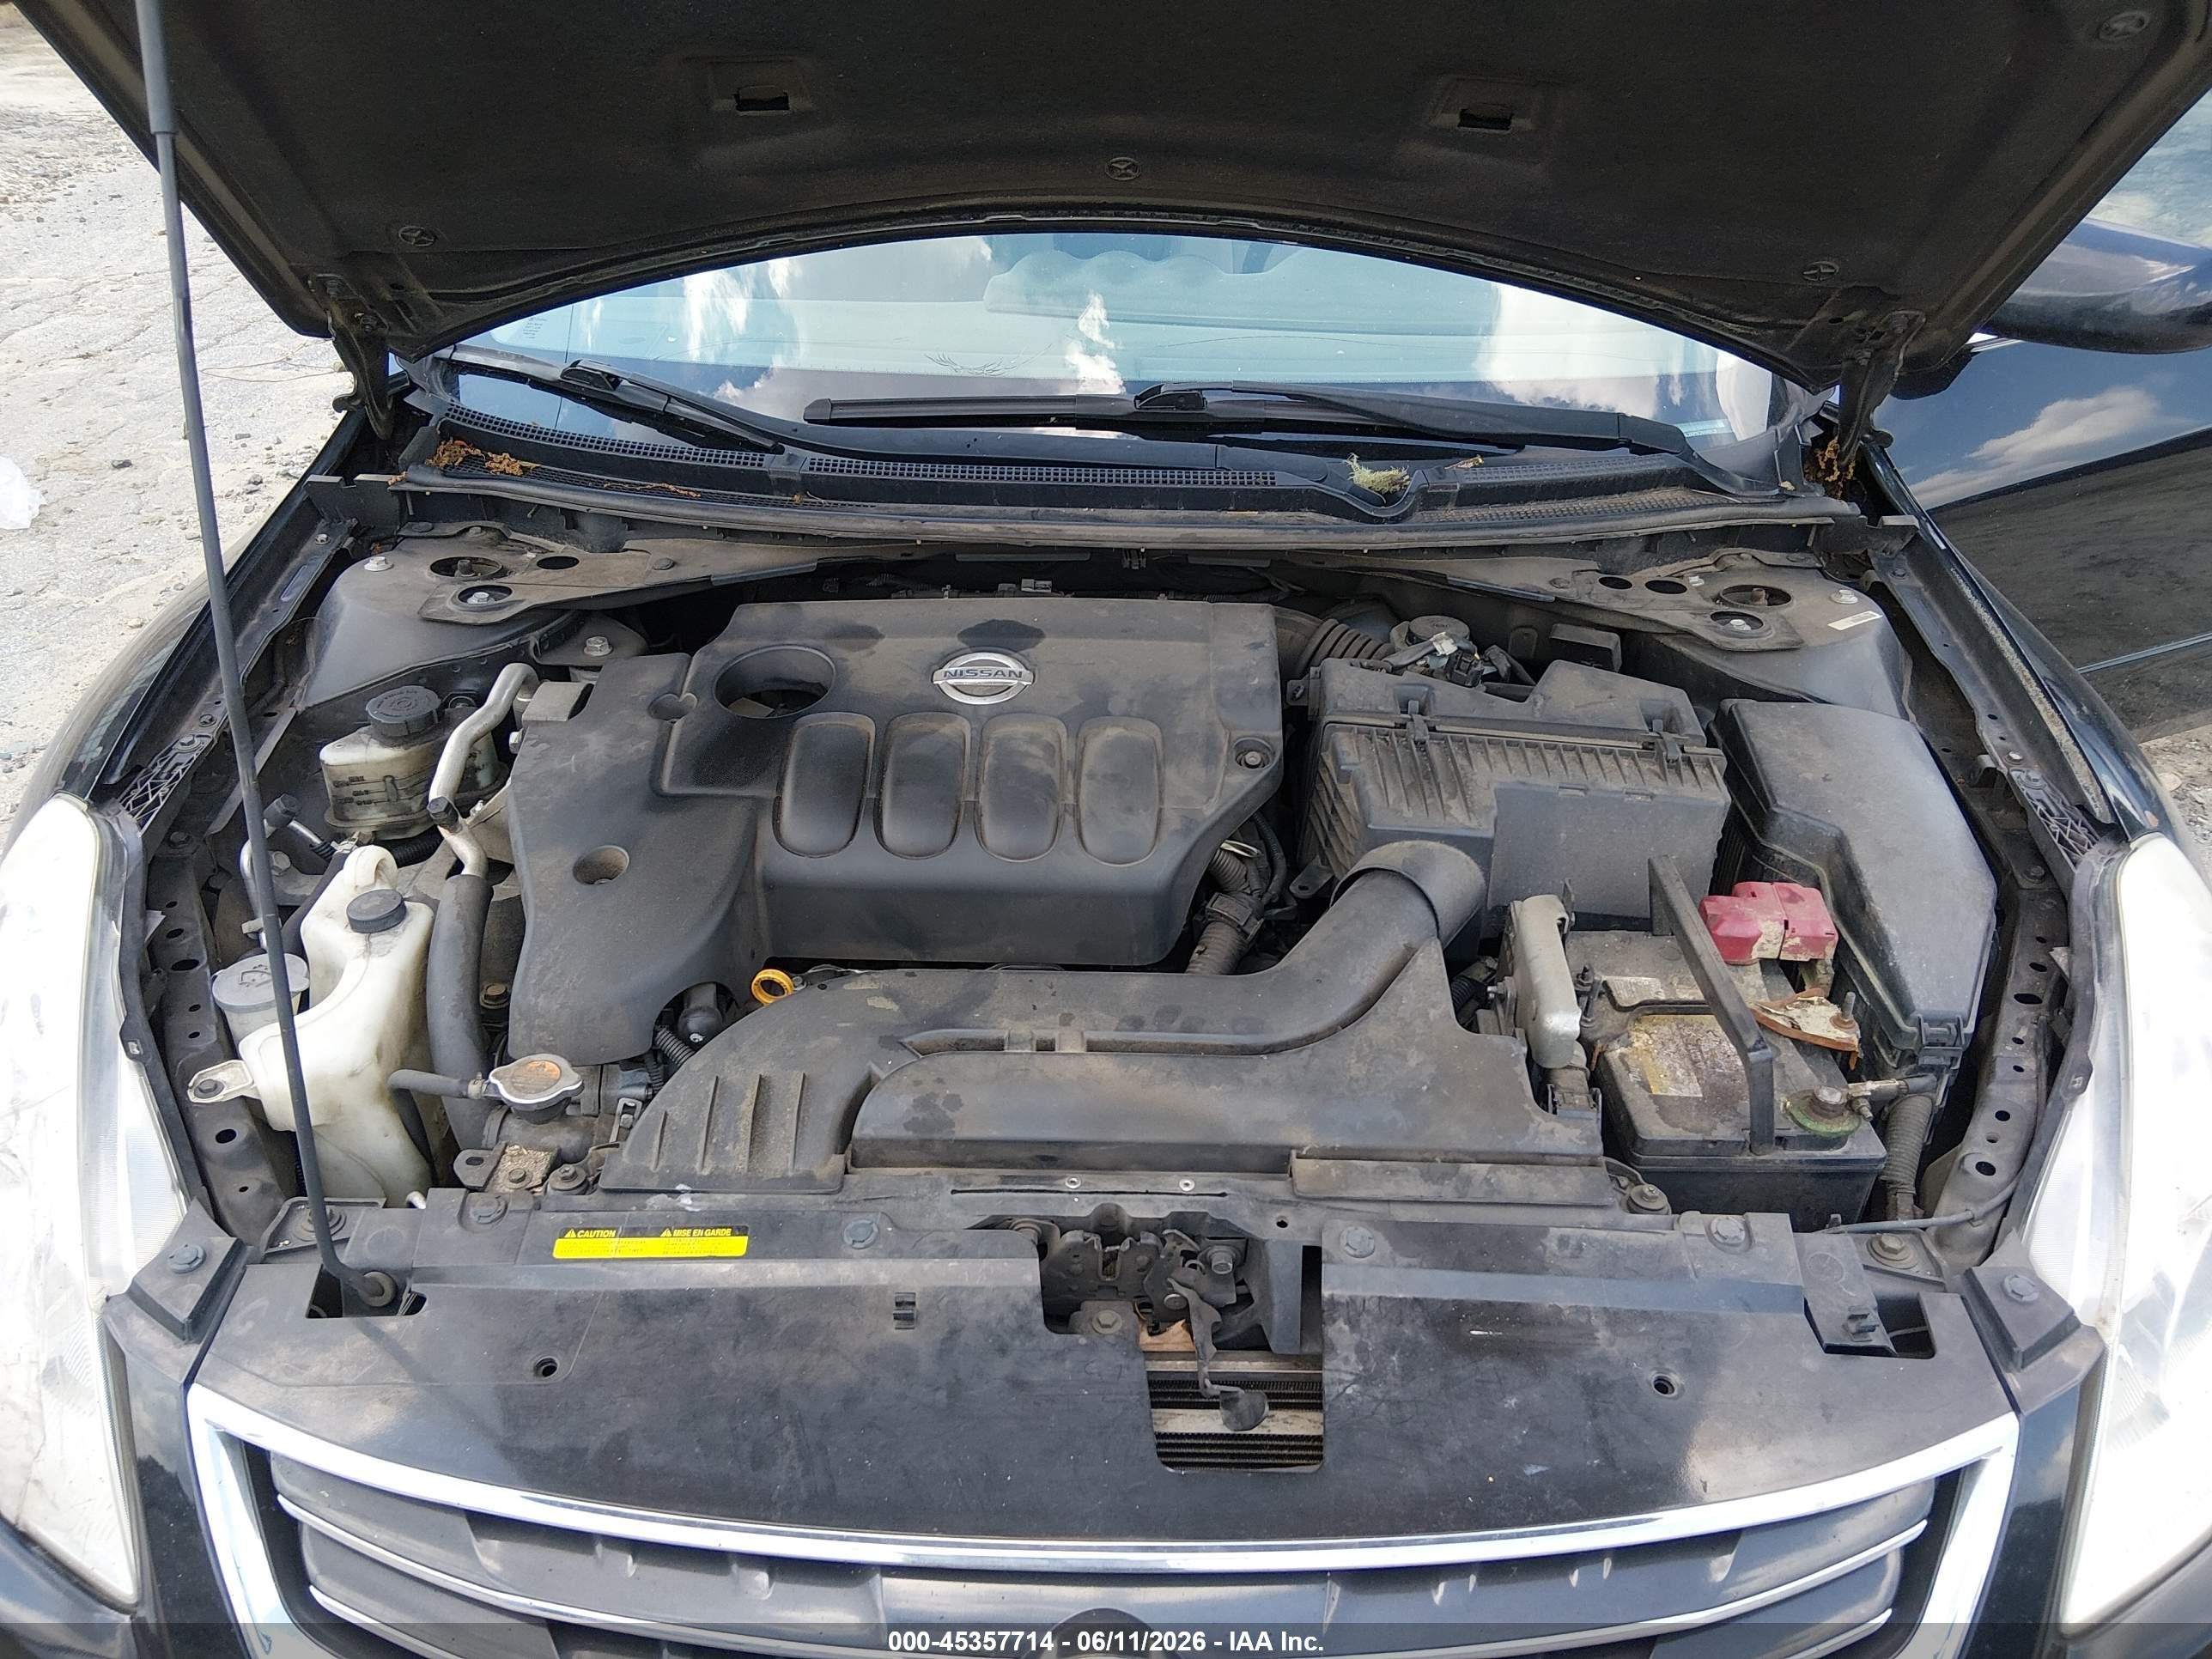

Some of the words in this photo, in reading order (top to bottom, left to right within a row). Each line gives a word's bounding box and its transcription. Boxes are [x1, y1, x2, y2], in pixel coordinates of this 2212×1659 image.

[943, 668, 1023, 678] NISSAN
[576, 1229, 617, 1238] CAUTION
[672, 1228, 692, 1237] MISE
[692, 1228, 704, 1237] EN
[704, 1228, 732, 1237] GARDE
